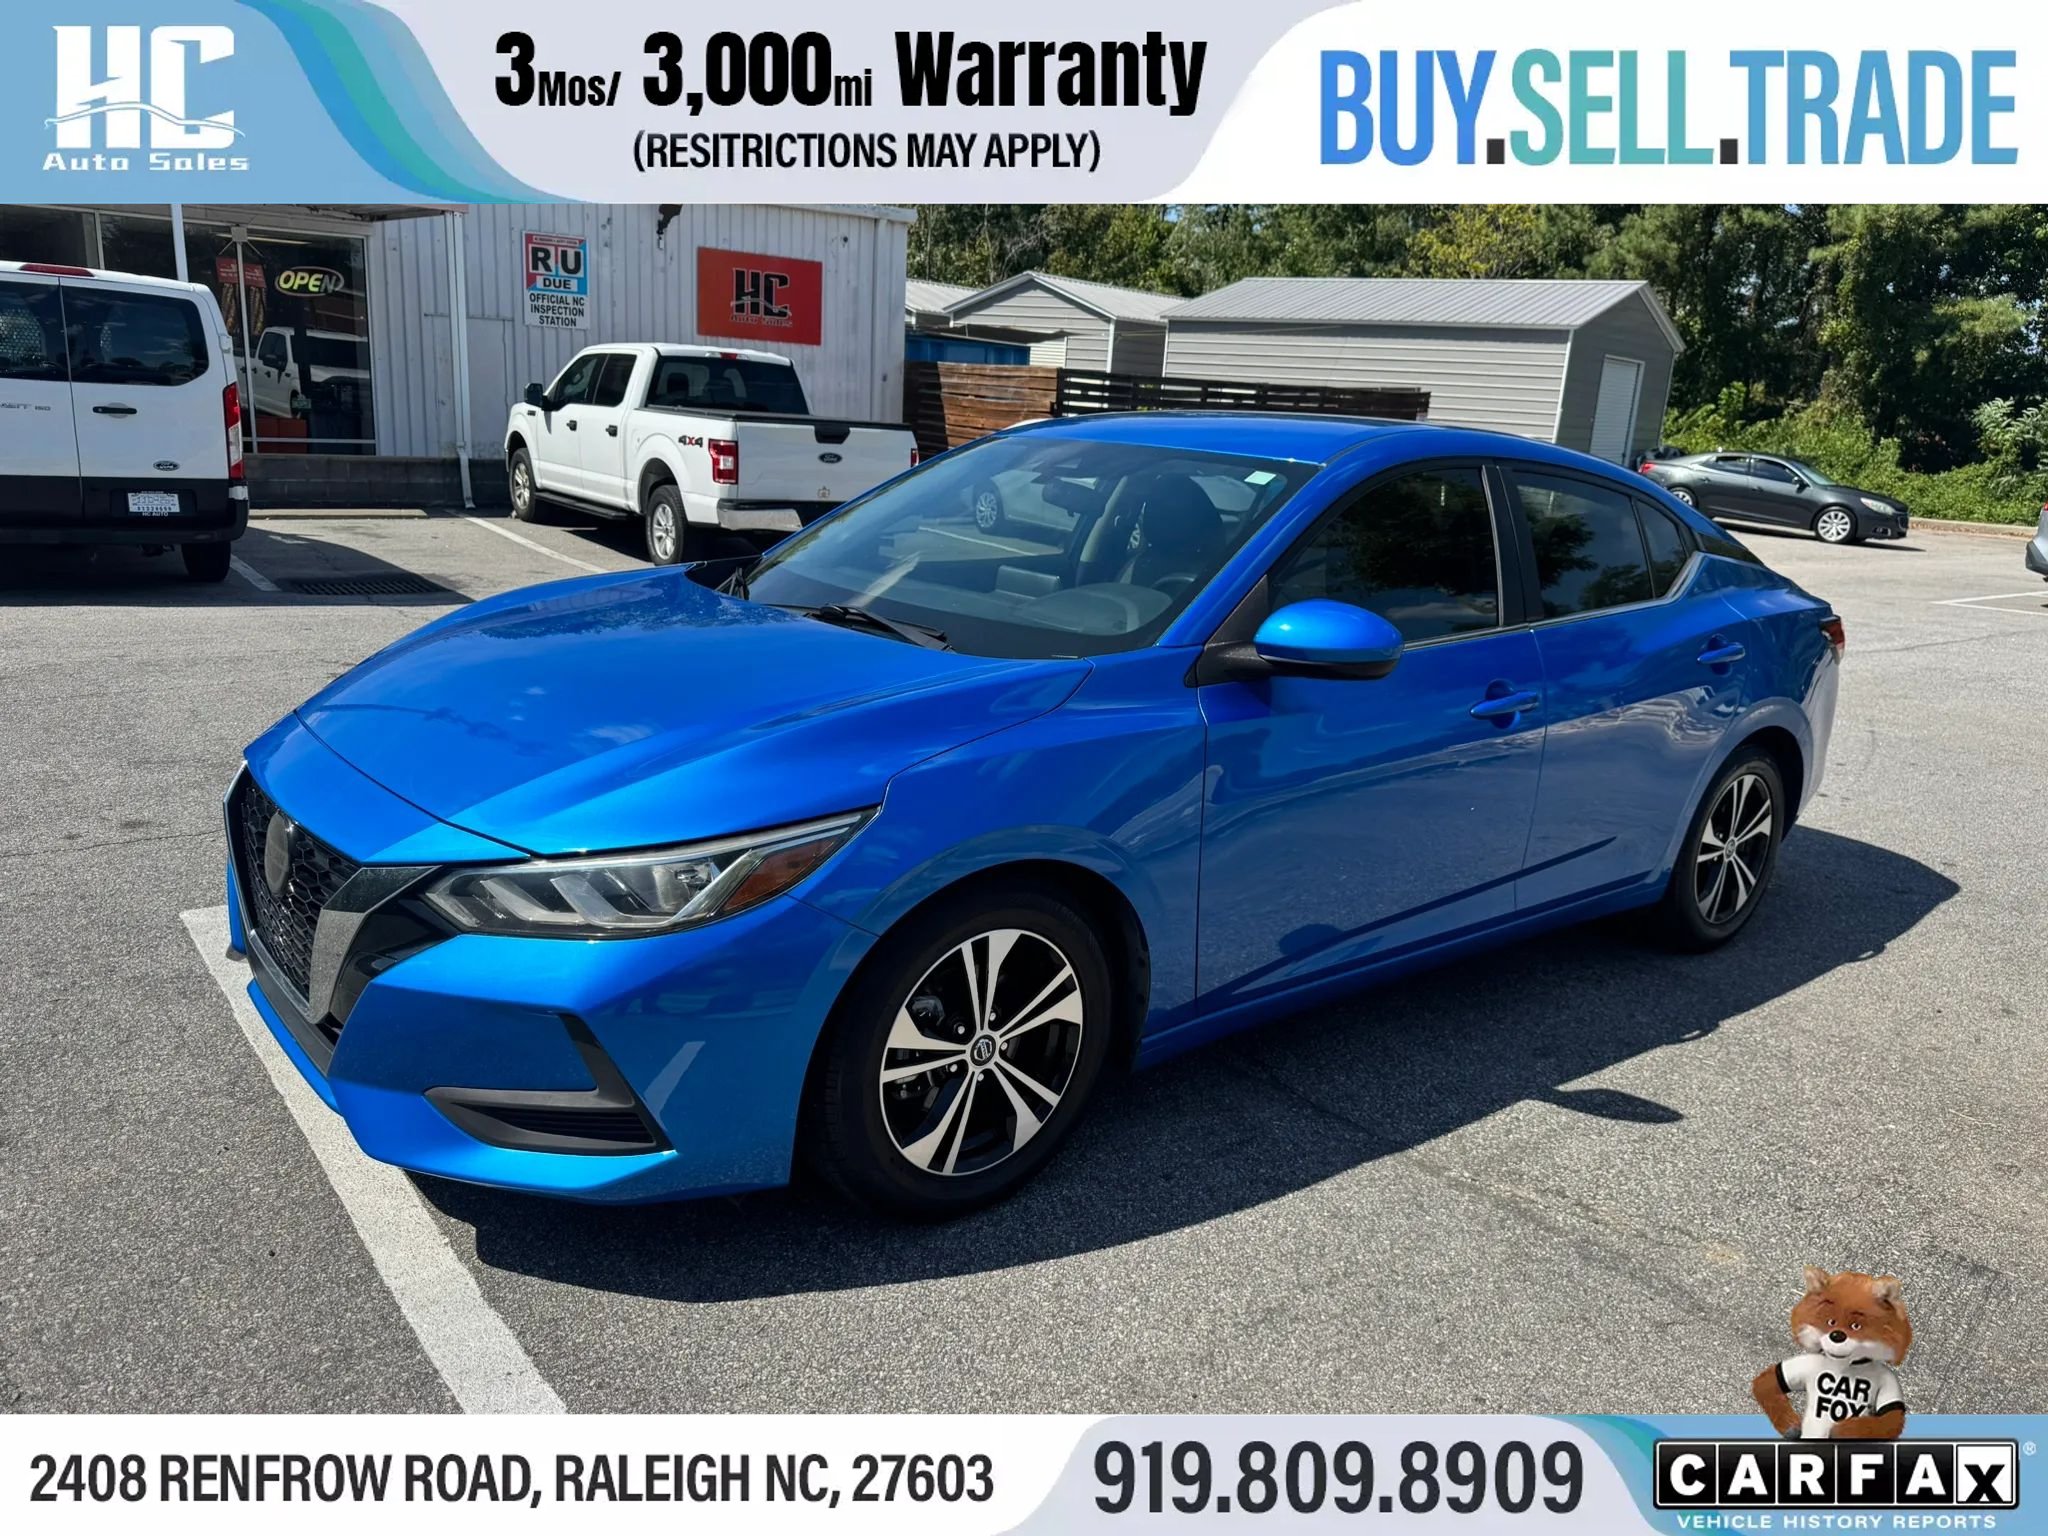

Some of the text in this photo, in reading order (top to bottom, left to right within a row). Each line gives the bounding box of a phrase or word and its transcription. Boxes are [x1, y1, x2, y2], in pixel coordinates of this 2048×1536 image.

[279, 270, 337, 293] OPEN
[543, 277, 572, 290] DUE
[529, 292, 585, 307] OFFICIAL NC
[733, 267, 790, 320] HC
[530, 303, 585, 317] INSPECTION
[538, 315, 577, 327] STATION
